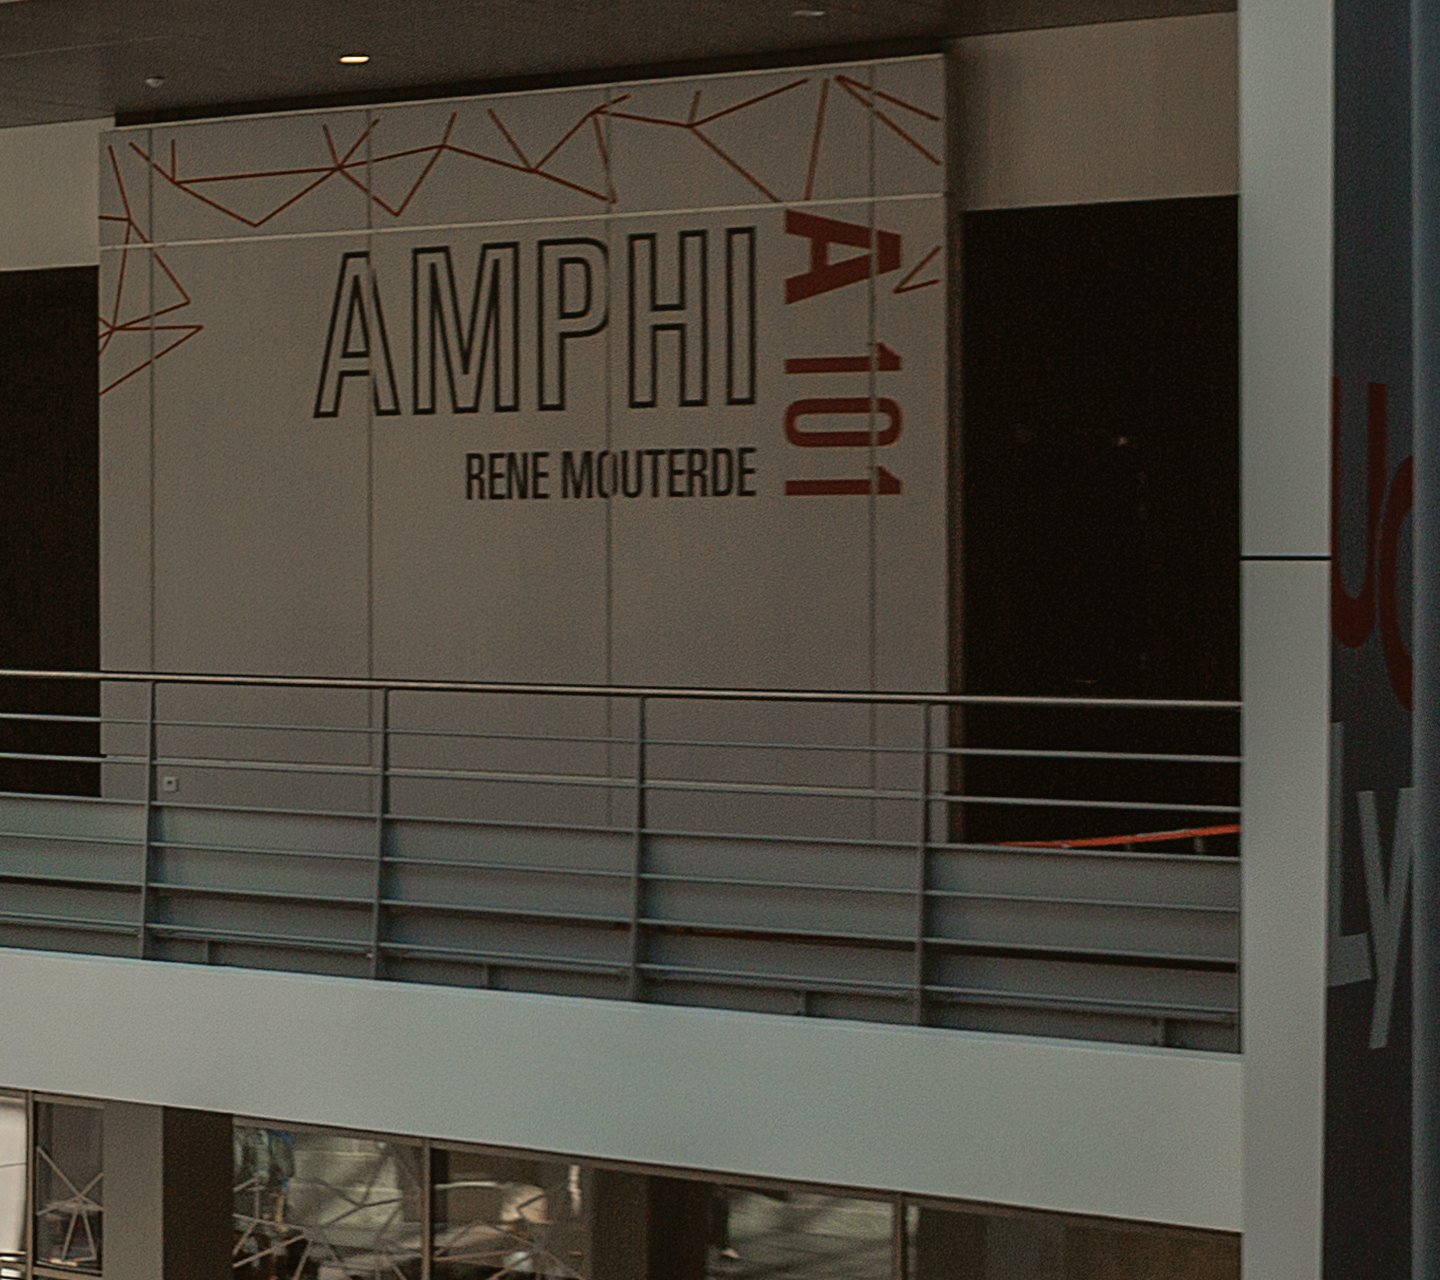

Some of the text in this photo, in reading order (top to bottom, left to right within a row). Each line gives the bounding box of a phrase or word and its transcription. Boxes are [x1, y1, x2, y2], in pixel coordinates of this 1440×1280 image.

[312, 225, 758, 419] AMPHI
[784, 209, 903, 497] A 101
[465, 446, 758, 501] RENE MOUTERDE
